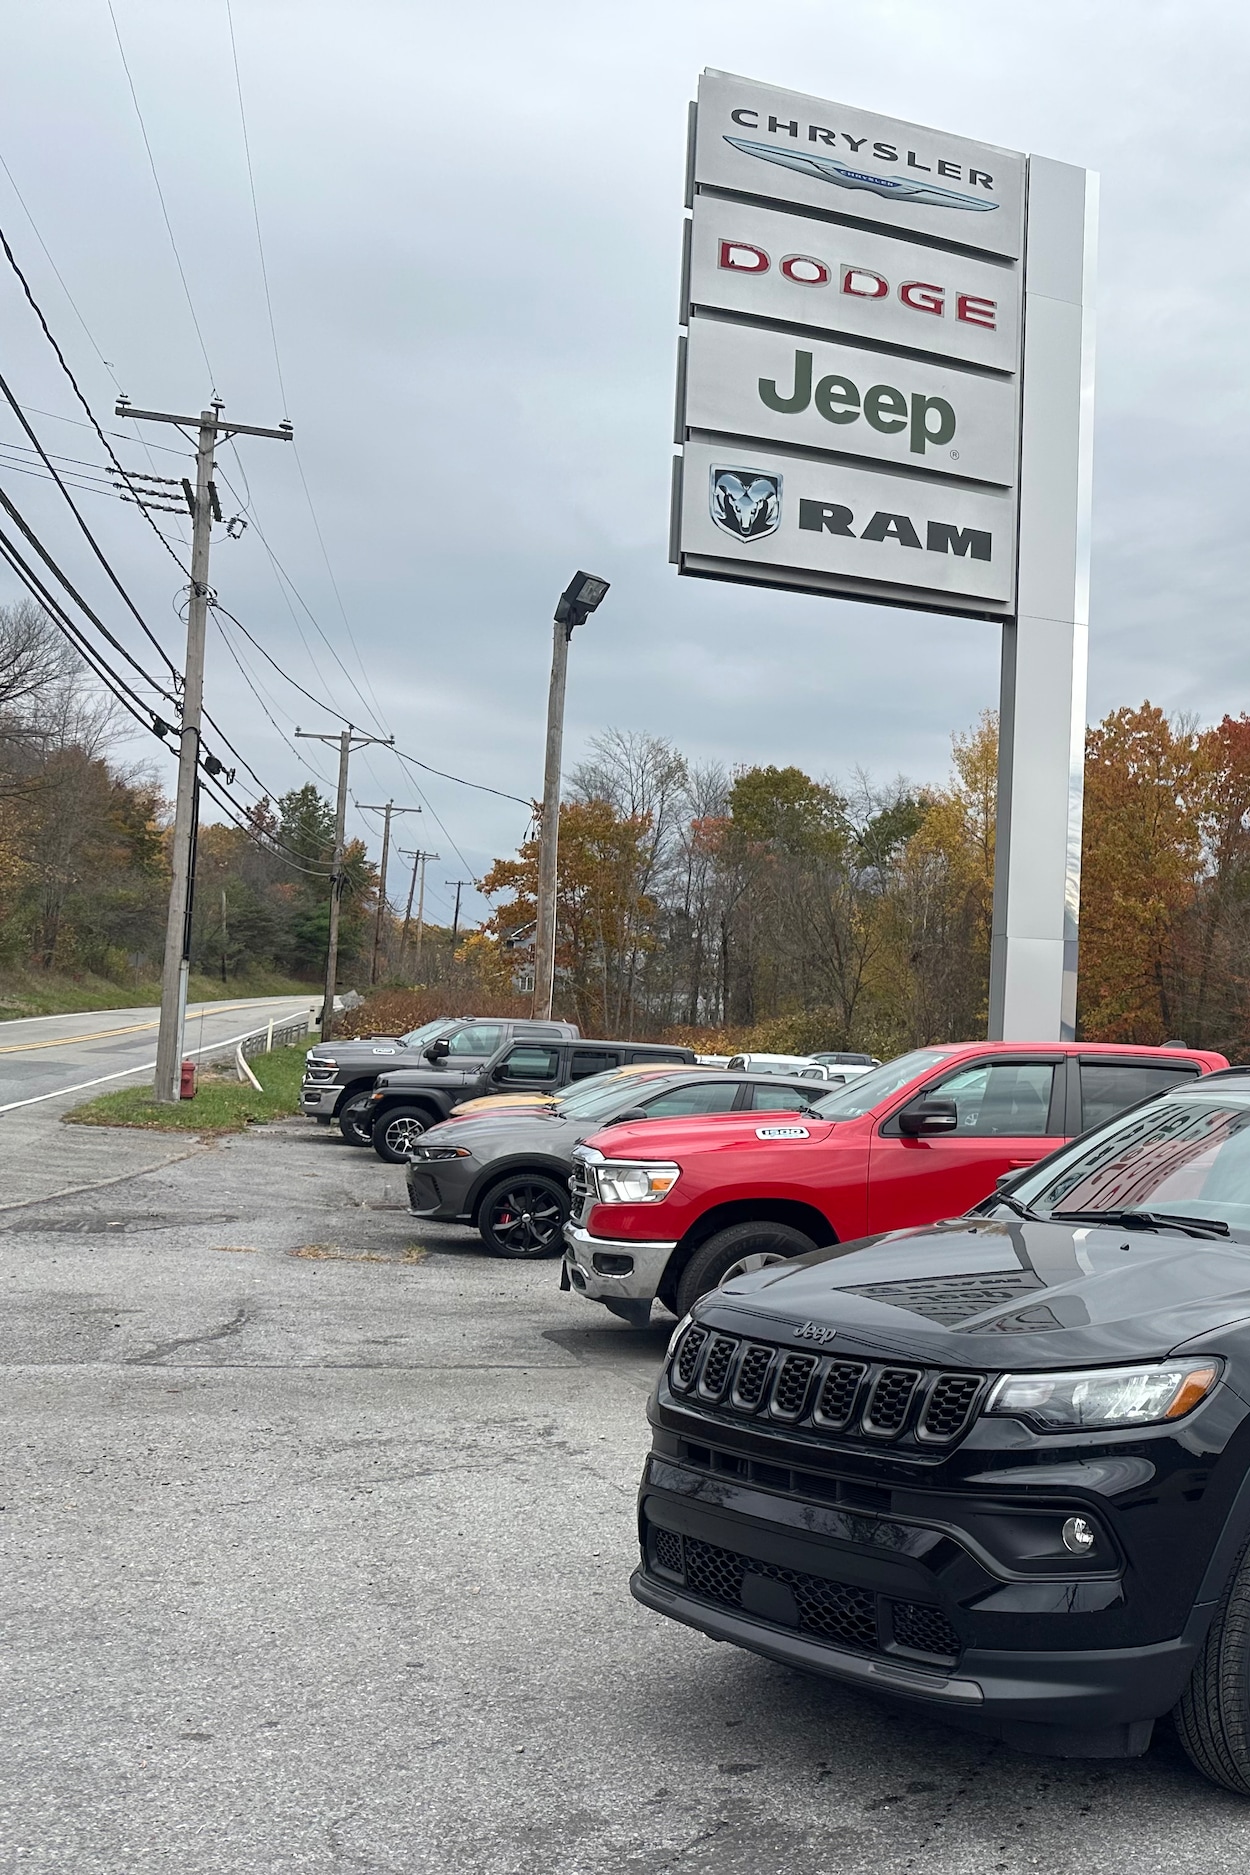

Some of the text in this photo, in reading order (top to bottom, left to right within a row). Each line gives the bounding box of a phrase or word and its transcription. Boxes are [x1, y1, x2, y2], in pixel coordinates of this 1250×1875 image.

[730, 108, 995, 191] CHRYSLER
[717, 238, 997, 331] DODGE
[758, 349, 957, 454] Jeep
[798, 497, 992, 562] RAM
[792, 1320, 838, 1346] Jeep
